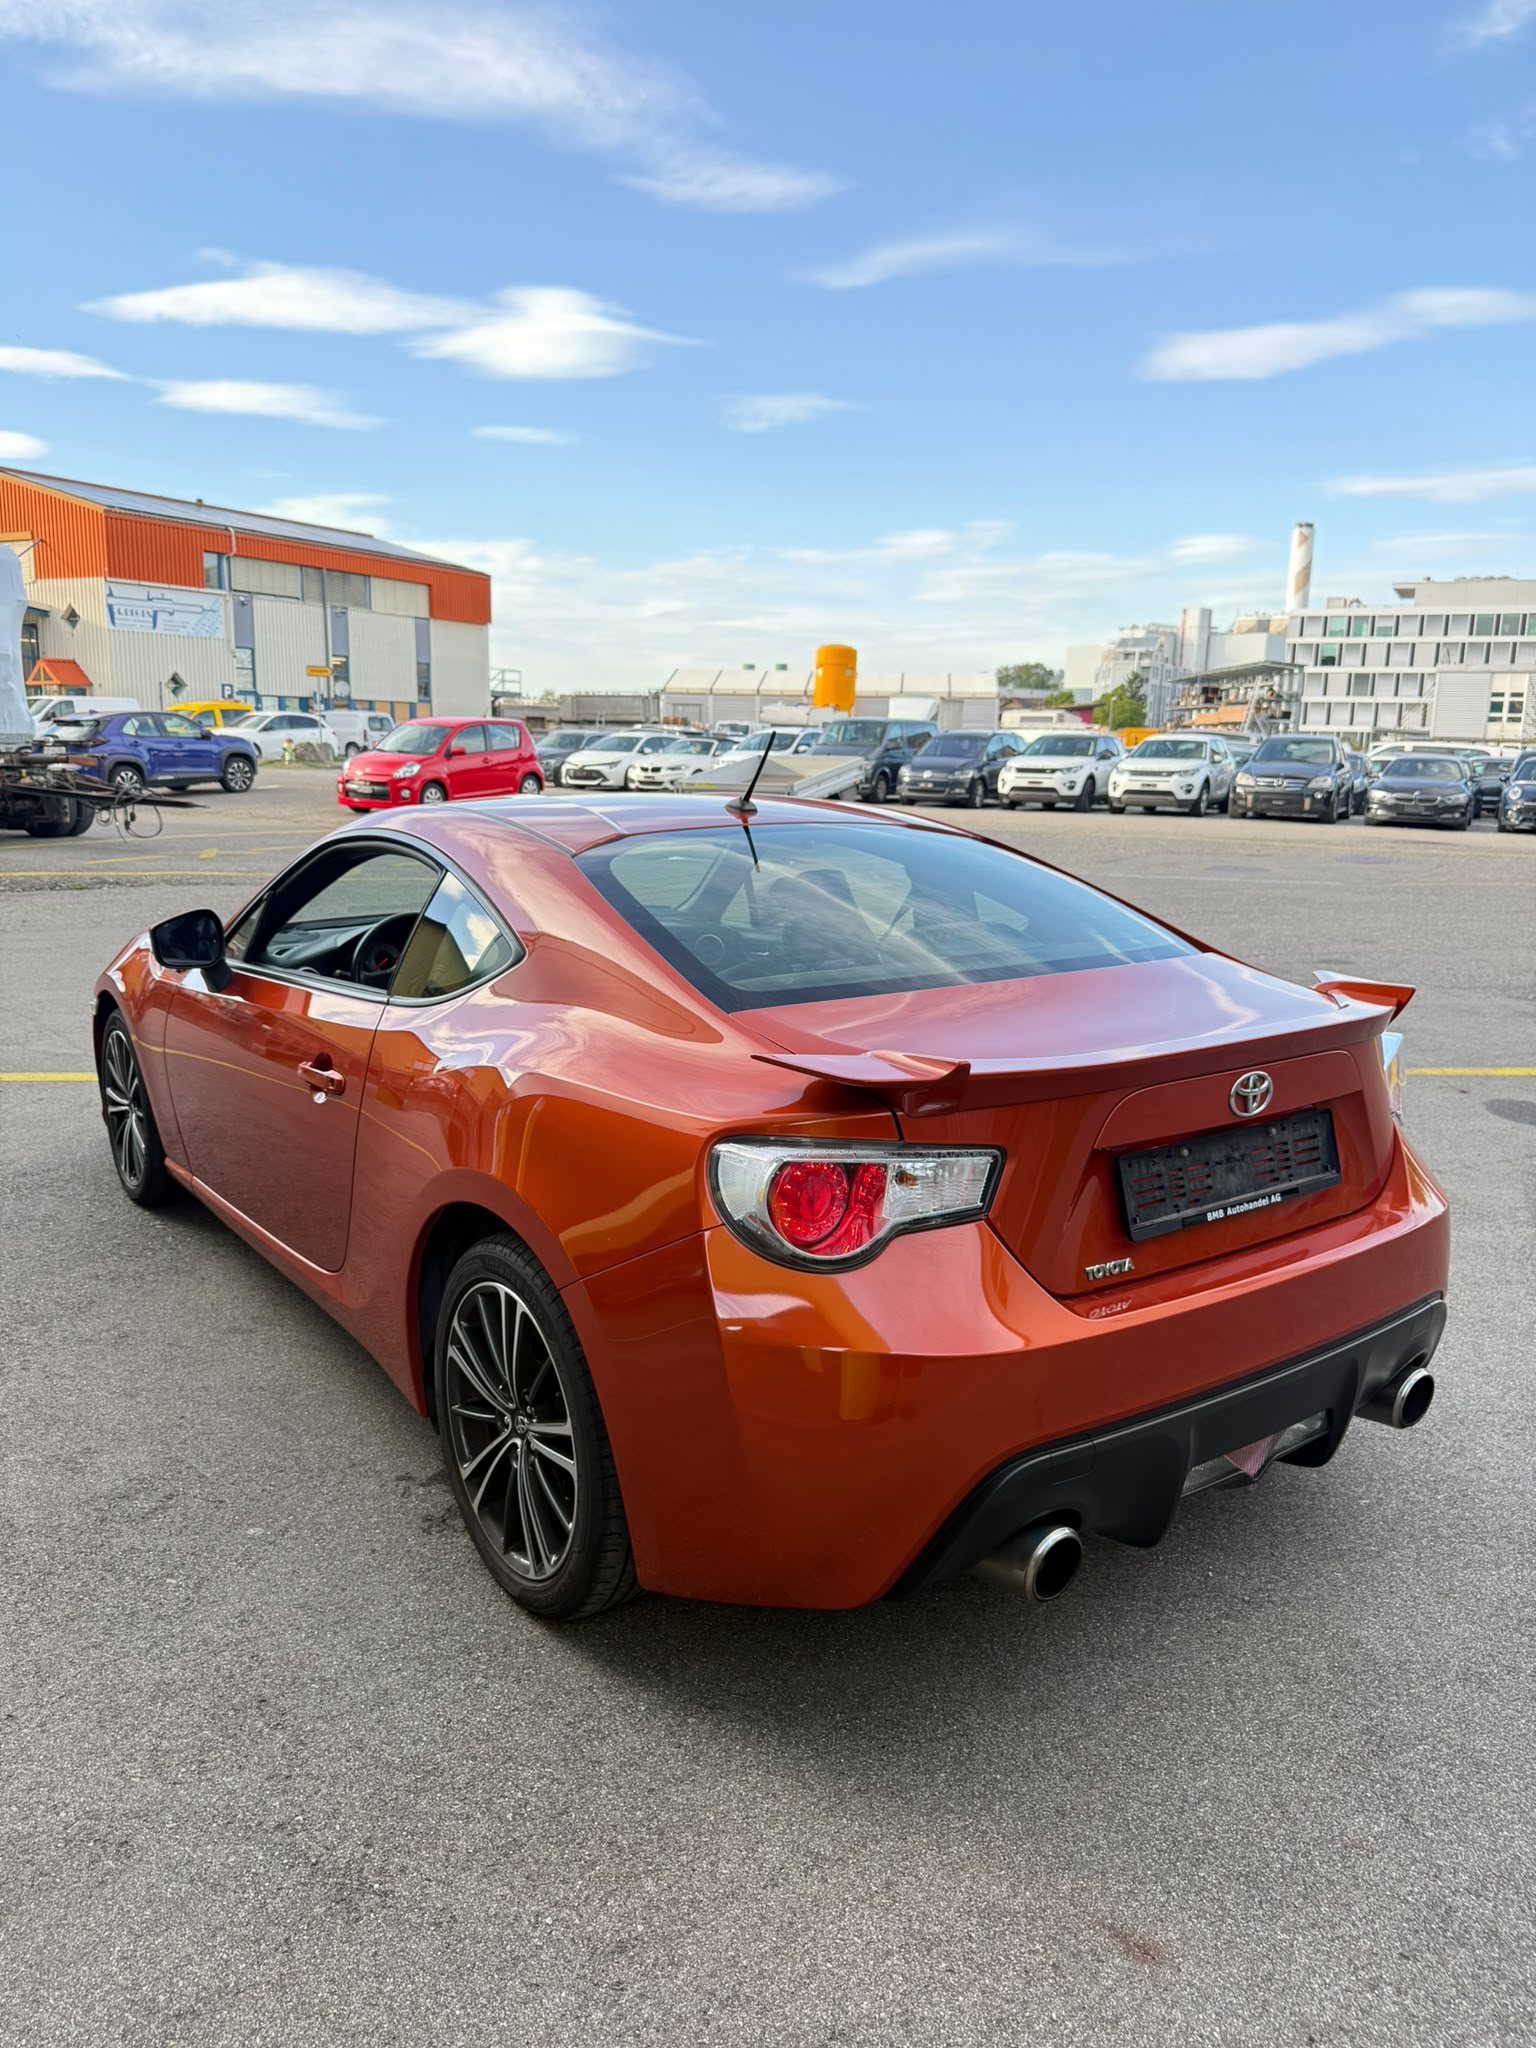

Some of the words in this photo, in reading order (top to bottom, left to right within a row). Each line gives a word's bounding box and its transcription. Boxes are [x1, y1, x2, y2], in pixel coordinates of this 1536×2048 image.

[224, 686, 231, 698] P
[1206, 1209, 1225, 1222] BMB
[1227, 1196, 1269, 1216] Autohandel
[1271, 1193, 1282, 1204] AG
[1084, 1257, 1135, 1281] TOYOTA
